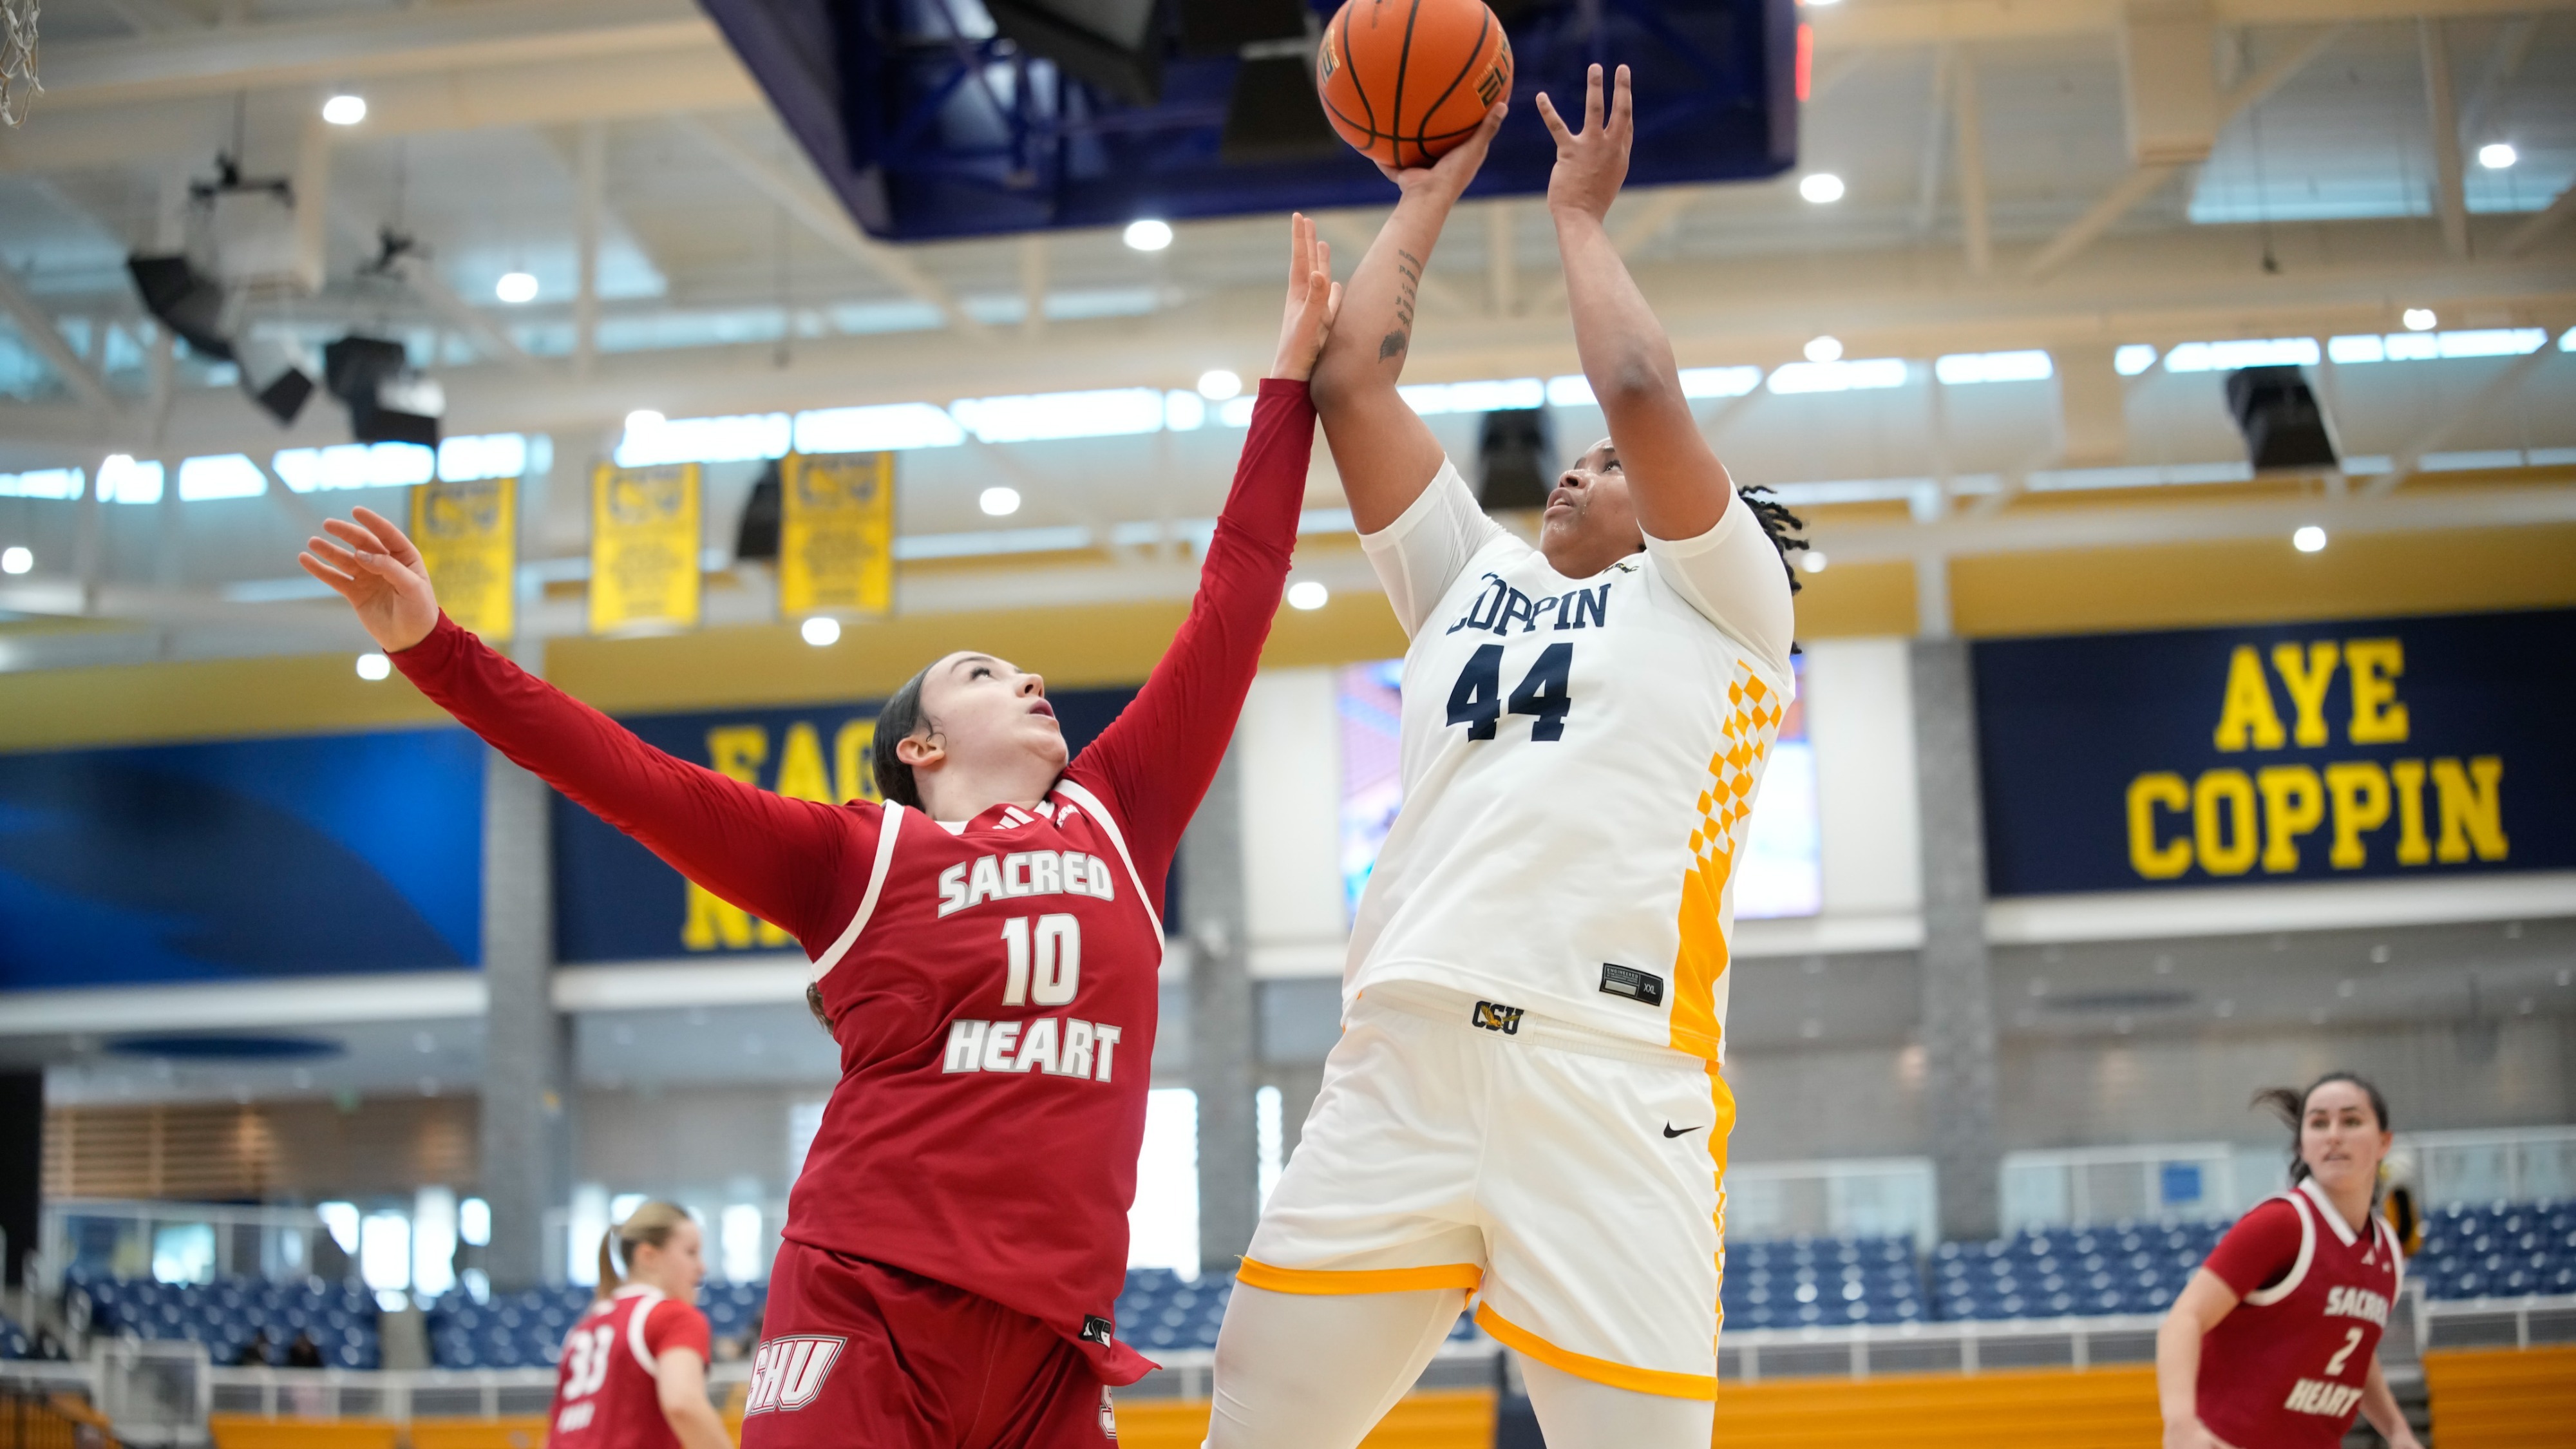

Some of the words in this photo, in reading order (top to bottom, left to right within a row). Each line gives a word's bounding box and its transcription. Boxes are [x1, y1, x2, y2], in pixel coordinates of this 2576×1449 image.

[1446, 571, 1611, 636] COPPIN
[1446, 642, 1573, 742] 44
[2213, 638, 2409, 752] AYE
[708, 721, 884, 805] EAG
[2126, 756, 2509, 880] COPPIN
[938, 850, 1114, 918] SACRED
[1001, 913, 1081, 1006] 10
[1607, 967, 1639, 979] ENGINEERED
[1643, 983, 1656, 995] XXL
[942, 1018, 1122, 1083] HEART
[1472, 1001, 1524, 1036] CSU
[744, 1334, 848, 1419] SHU
[2324, 1327, 2364, 1376] 2
[2284, 1377, 2364, 1419] HEART
